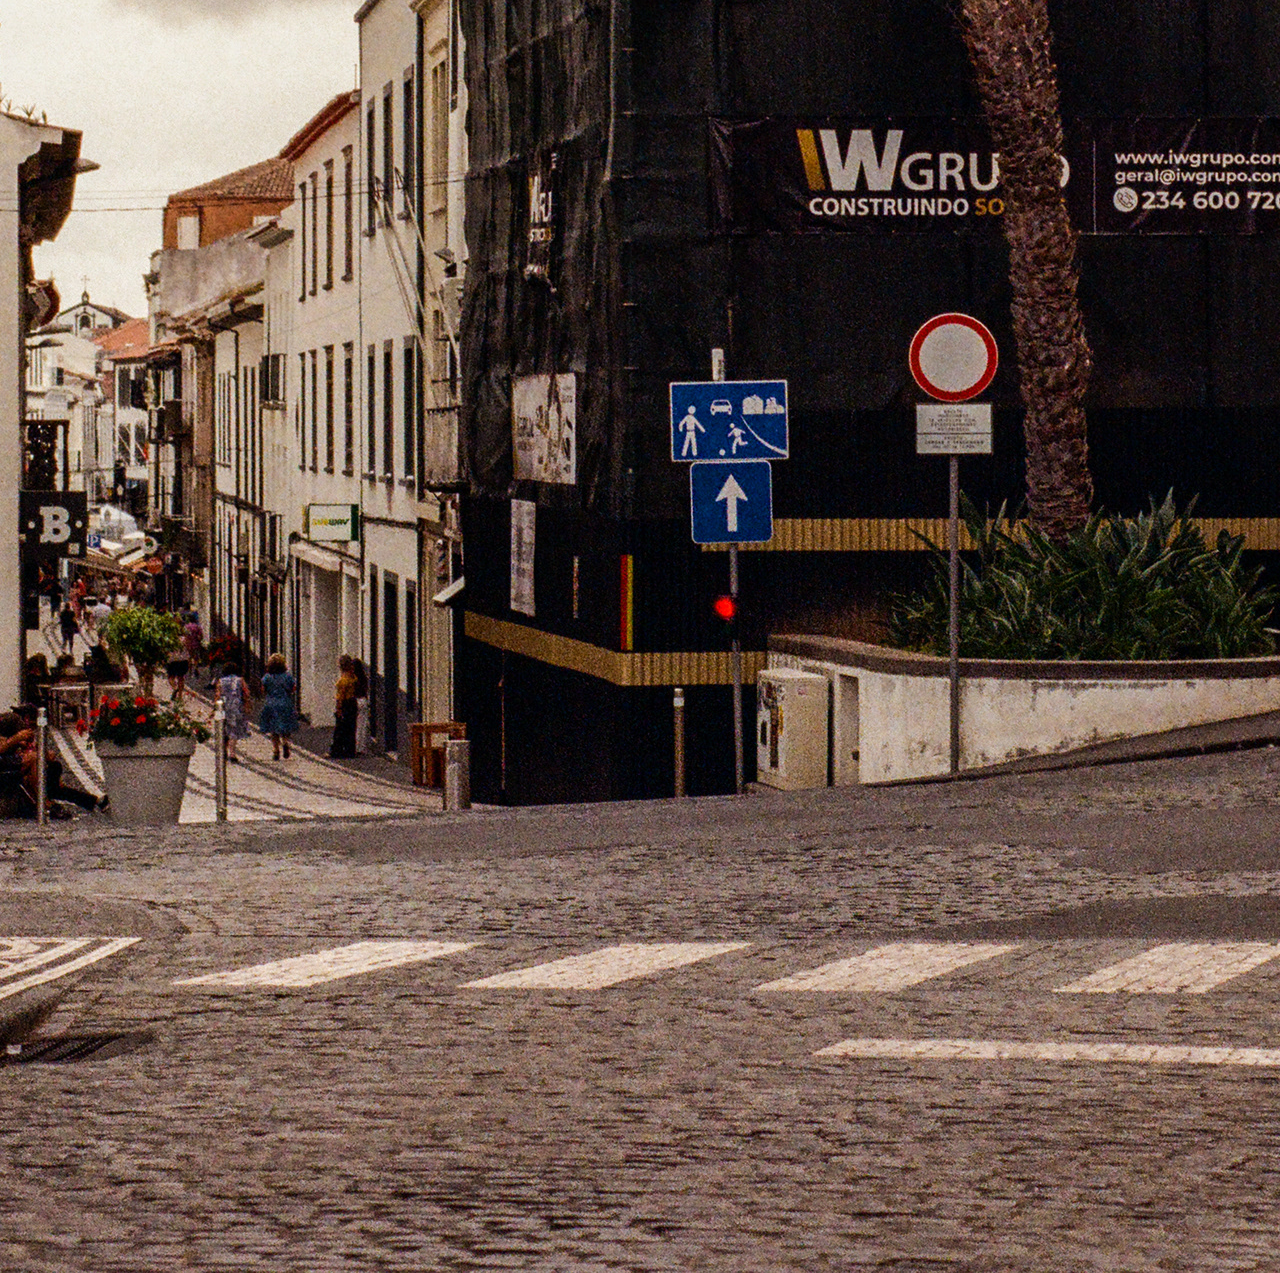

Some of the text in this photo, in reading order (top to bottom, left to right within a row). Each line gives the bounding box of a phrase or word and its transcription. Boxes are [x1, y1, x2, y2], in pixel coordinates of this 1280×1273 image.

[809, 197, 969, 216] CONSTRUINDO
[1141, 191, 1186, 210] 234
[1193, 191, 1240, 210] 600
